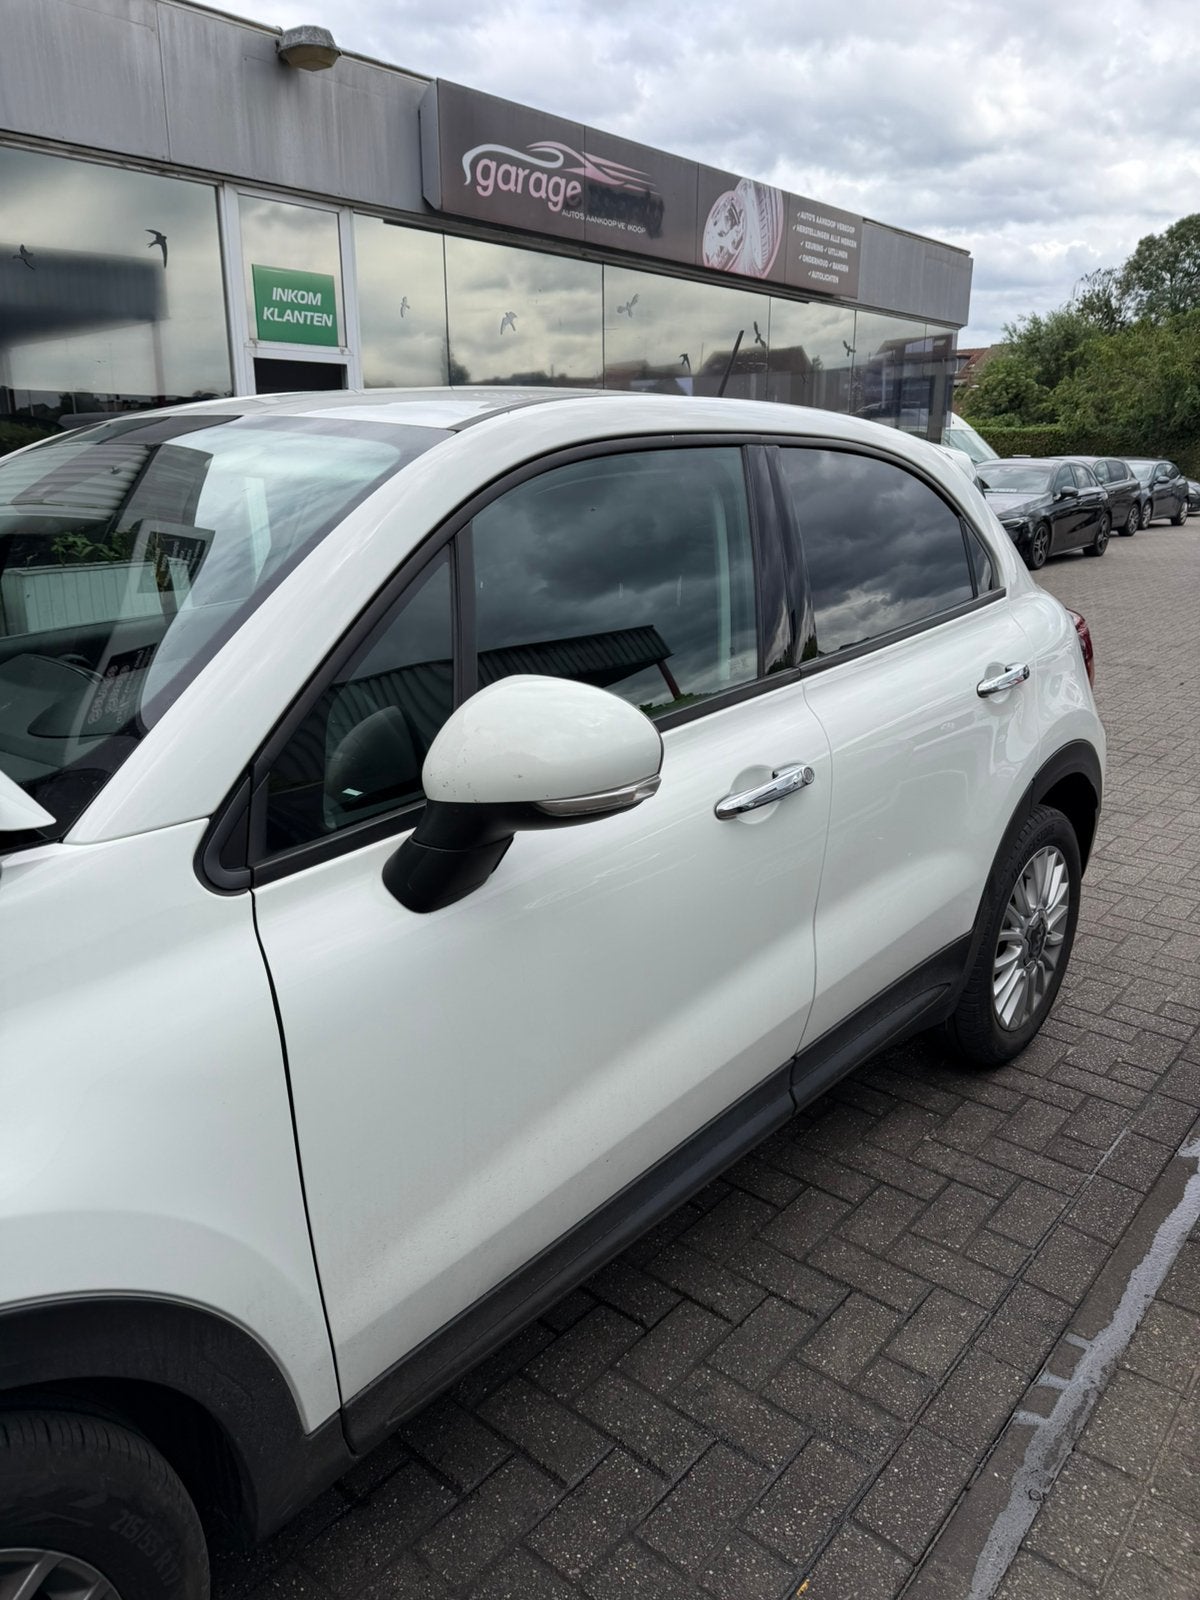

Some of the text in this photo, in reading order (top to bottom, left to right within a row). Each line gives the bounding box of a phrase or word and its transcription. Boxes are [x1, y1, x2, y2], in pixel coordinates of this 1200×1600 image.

[476, 158, 582, 212] garage
[586, 215, 617, 227] AANKOOP
[617, 221, 646, 234] VEKOOP
[272, 287, 322, 306] INKOM
[263, 306, 333, 328] KLANTEN
